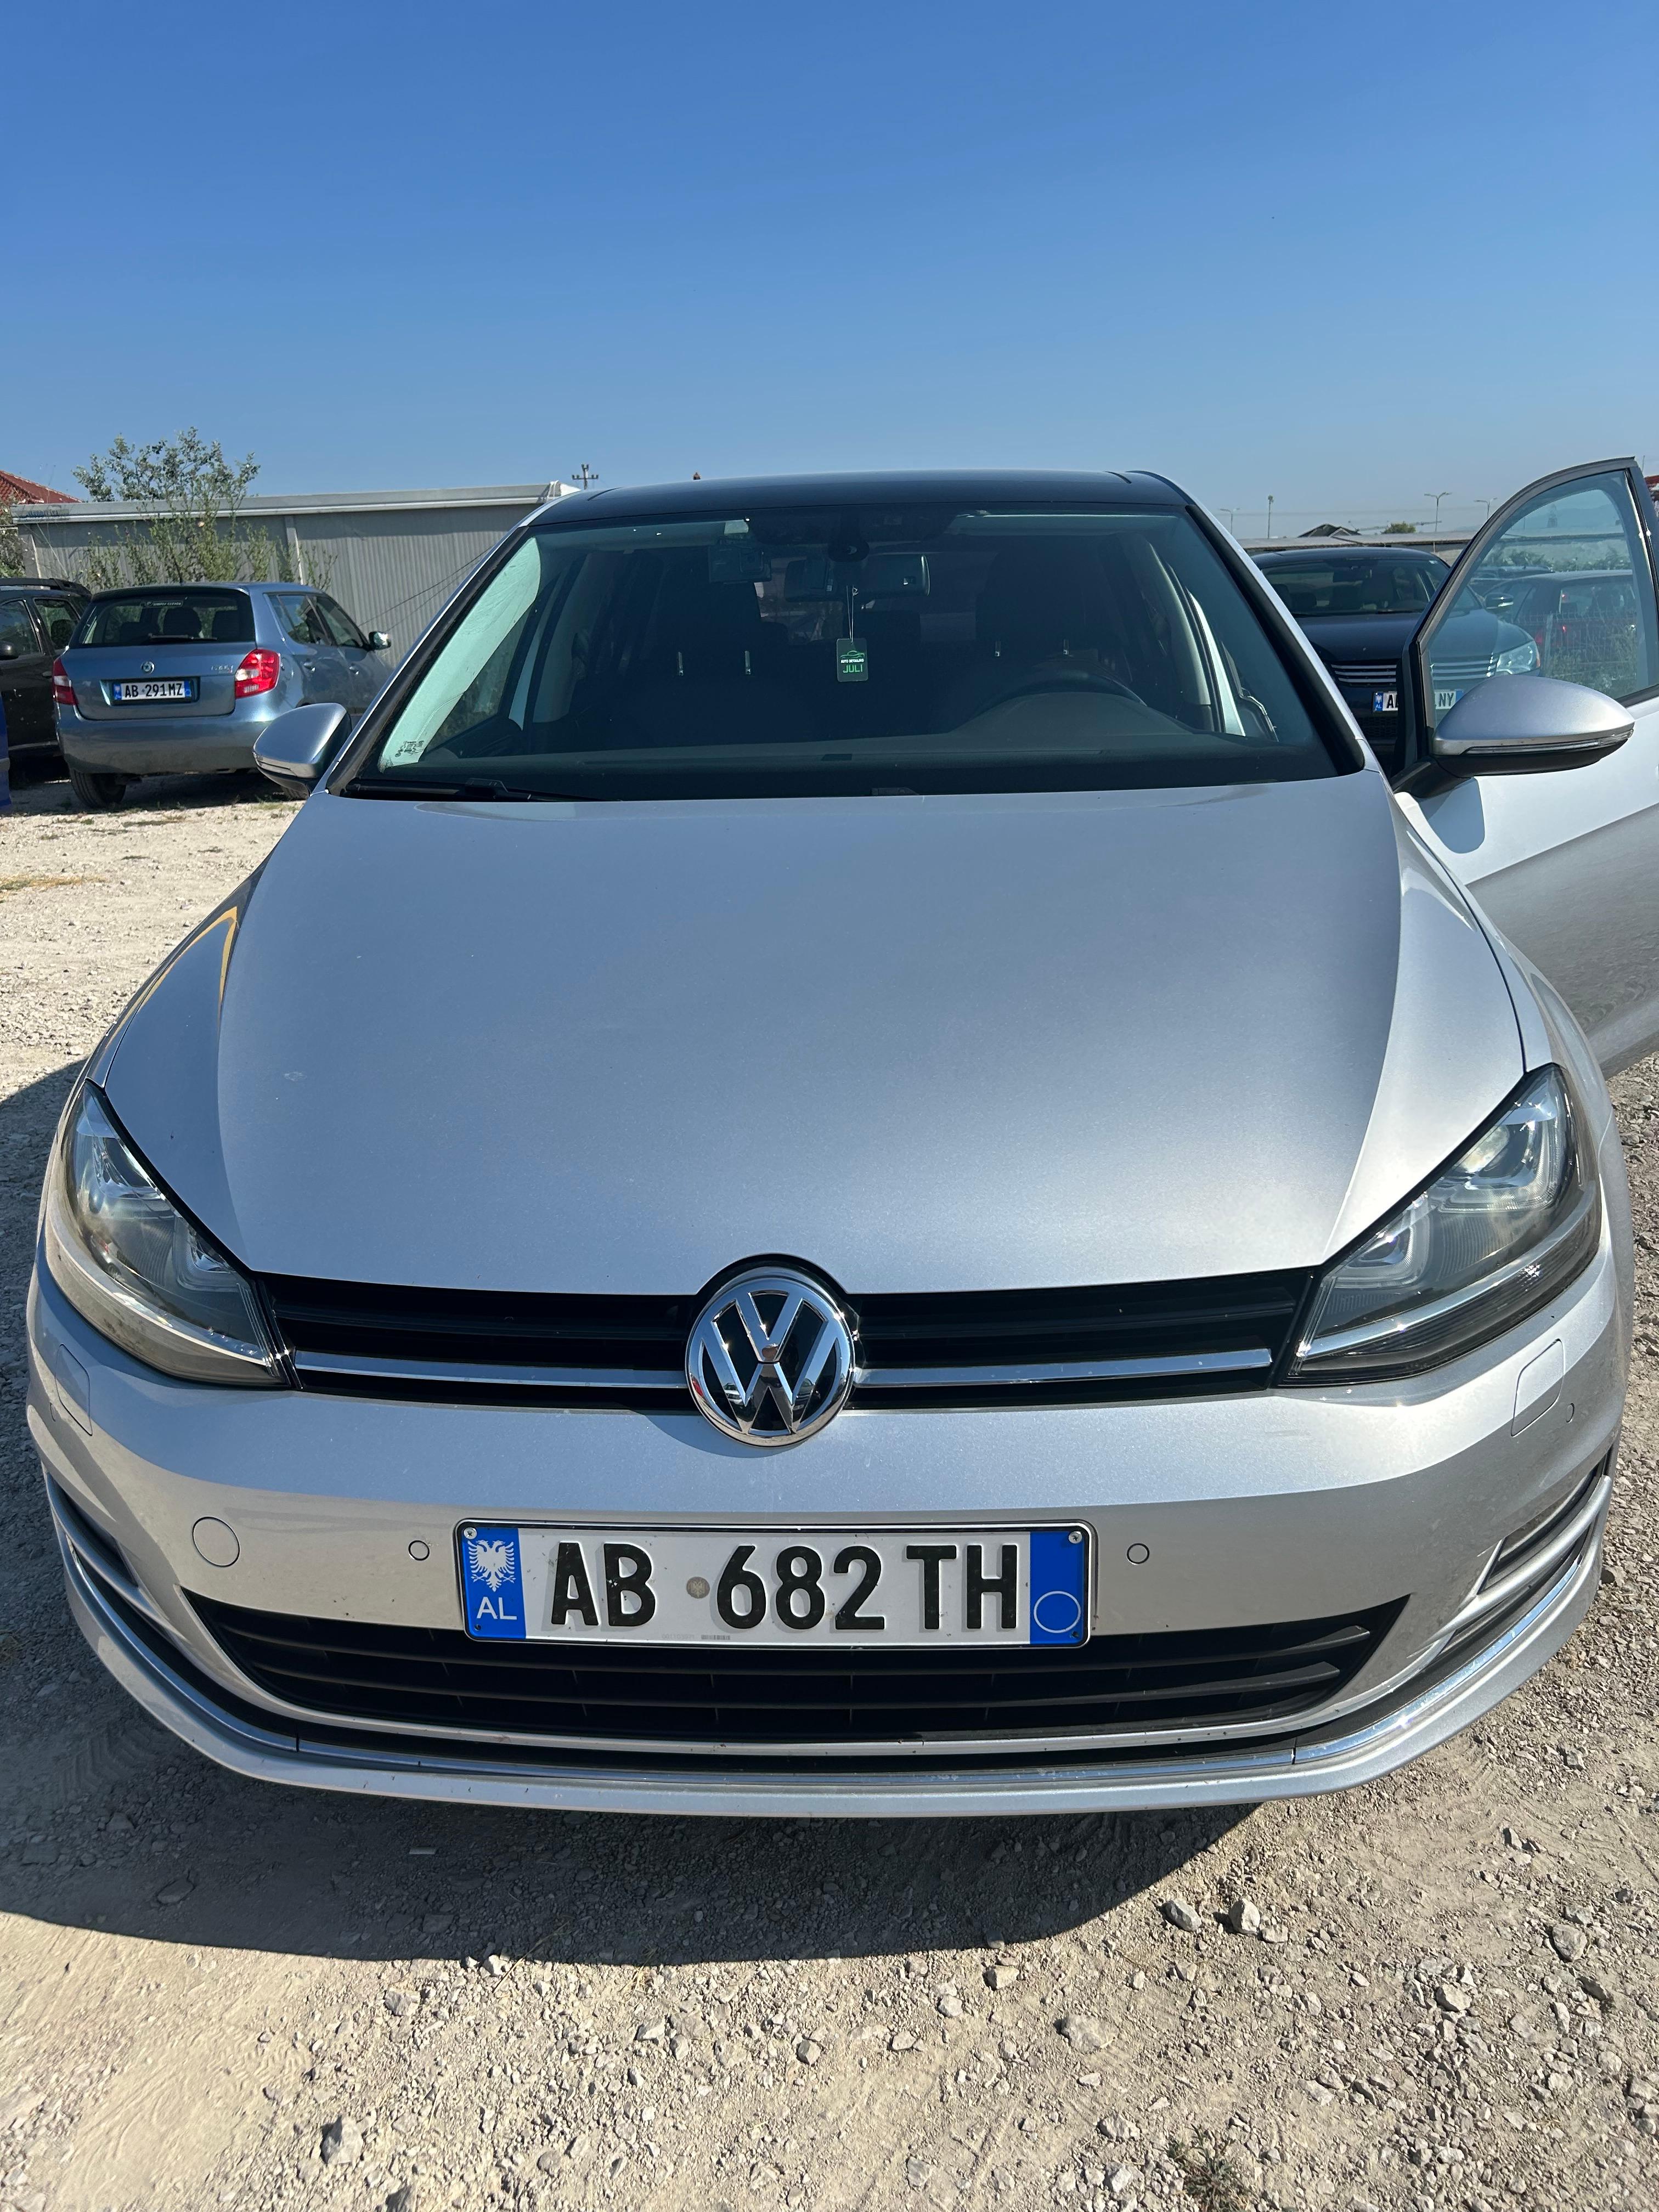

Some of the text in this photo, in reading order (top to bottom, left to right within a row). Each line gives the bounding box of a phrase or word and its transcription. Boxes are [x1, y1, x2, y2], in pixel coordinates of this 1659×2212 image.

[843, 664, 863, 673] JULI
[125, 683, 183, 697] AB 291 MZ
[551, 1542, 1018, 1630] AB 682 TH
[476, 1598, 517, 1622] AL
